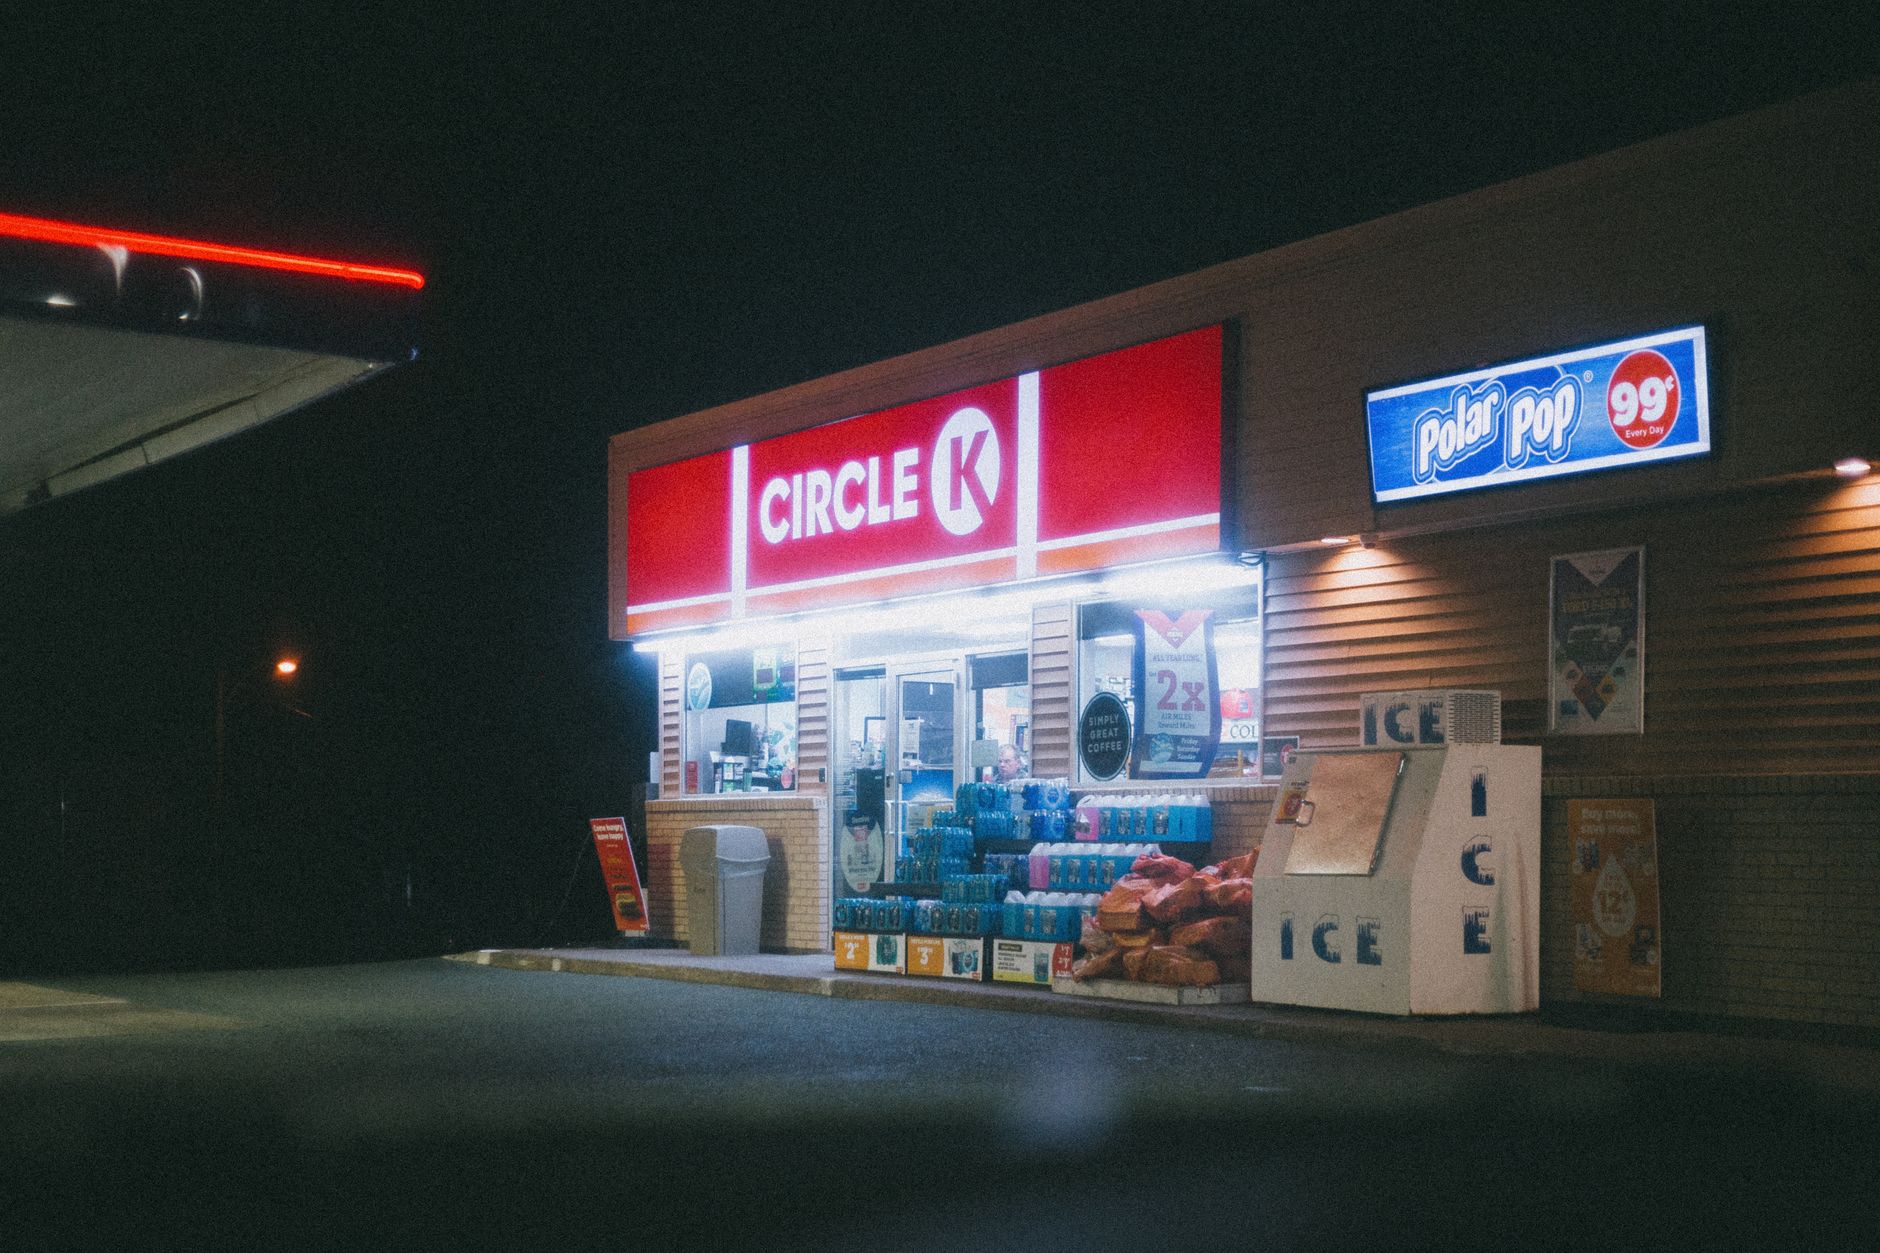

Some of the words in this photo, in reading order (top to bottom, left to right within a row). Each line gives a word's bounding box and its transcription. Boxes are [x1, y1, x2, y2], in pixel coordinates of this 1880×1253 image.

[1419, 391, 1499, 474] Polar
[1625, 427, 1647, 439] Every
[1649, 425, 1664, 436] Day
[759, 447, 919, 544] CIRCLE
[947, 426, 995, 526] K
[1088, 714, 1119, 727] SIMPLY
[1089, 728, 1119, 740] GREAT
[1363, 699, 1446, 745] ICE
[1087, 741, 1123, 754] COFFEE
[1460, 766, 1496, 955] ICE
[1280, 912, 1382, 966] ICE
